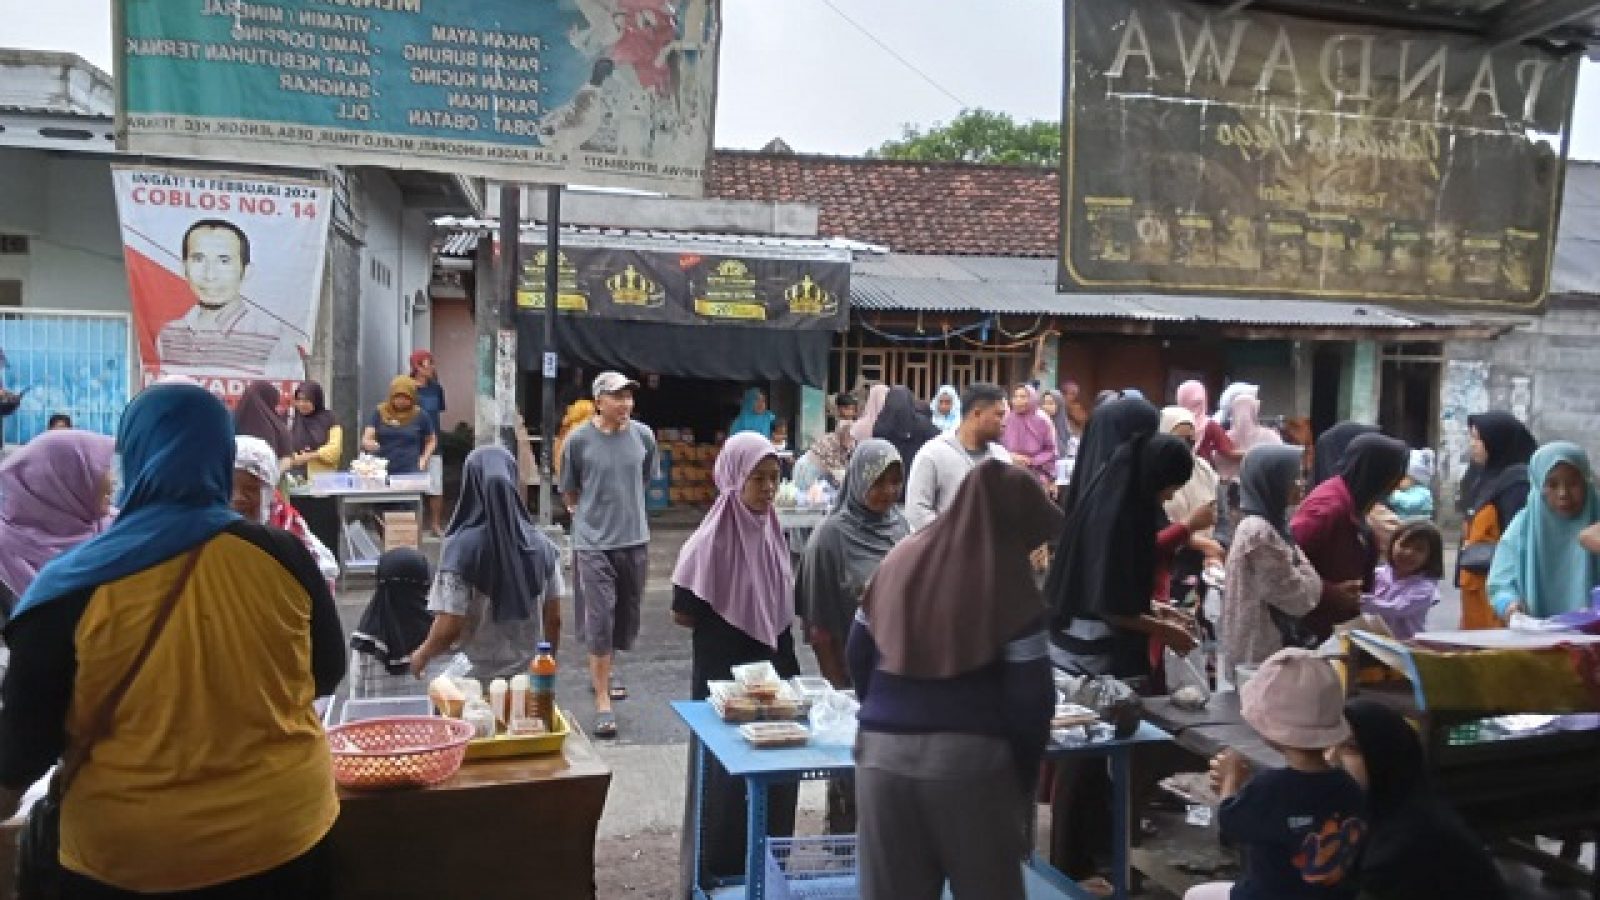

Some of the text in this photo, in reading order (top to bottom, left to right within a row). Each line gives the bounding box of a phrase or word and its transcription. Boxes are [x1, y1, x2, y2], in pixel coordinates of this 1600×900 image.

[190, 179, 206, 189] 14
[209, 180, 281, 195] FEBRUARI
[284, 187, 316, 200] 2024
[132, 187, 316, 220] COBLOS NO. 14
